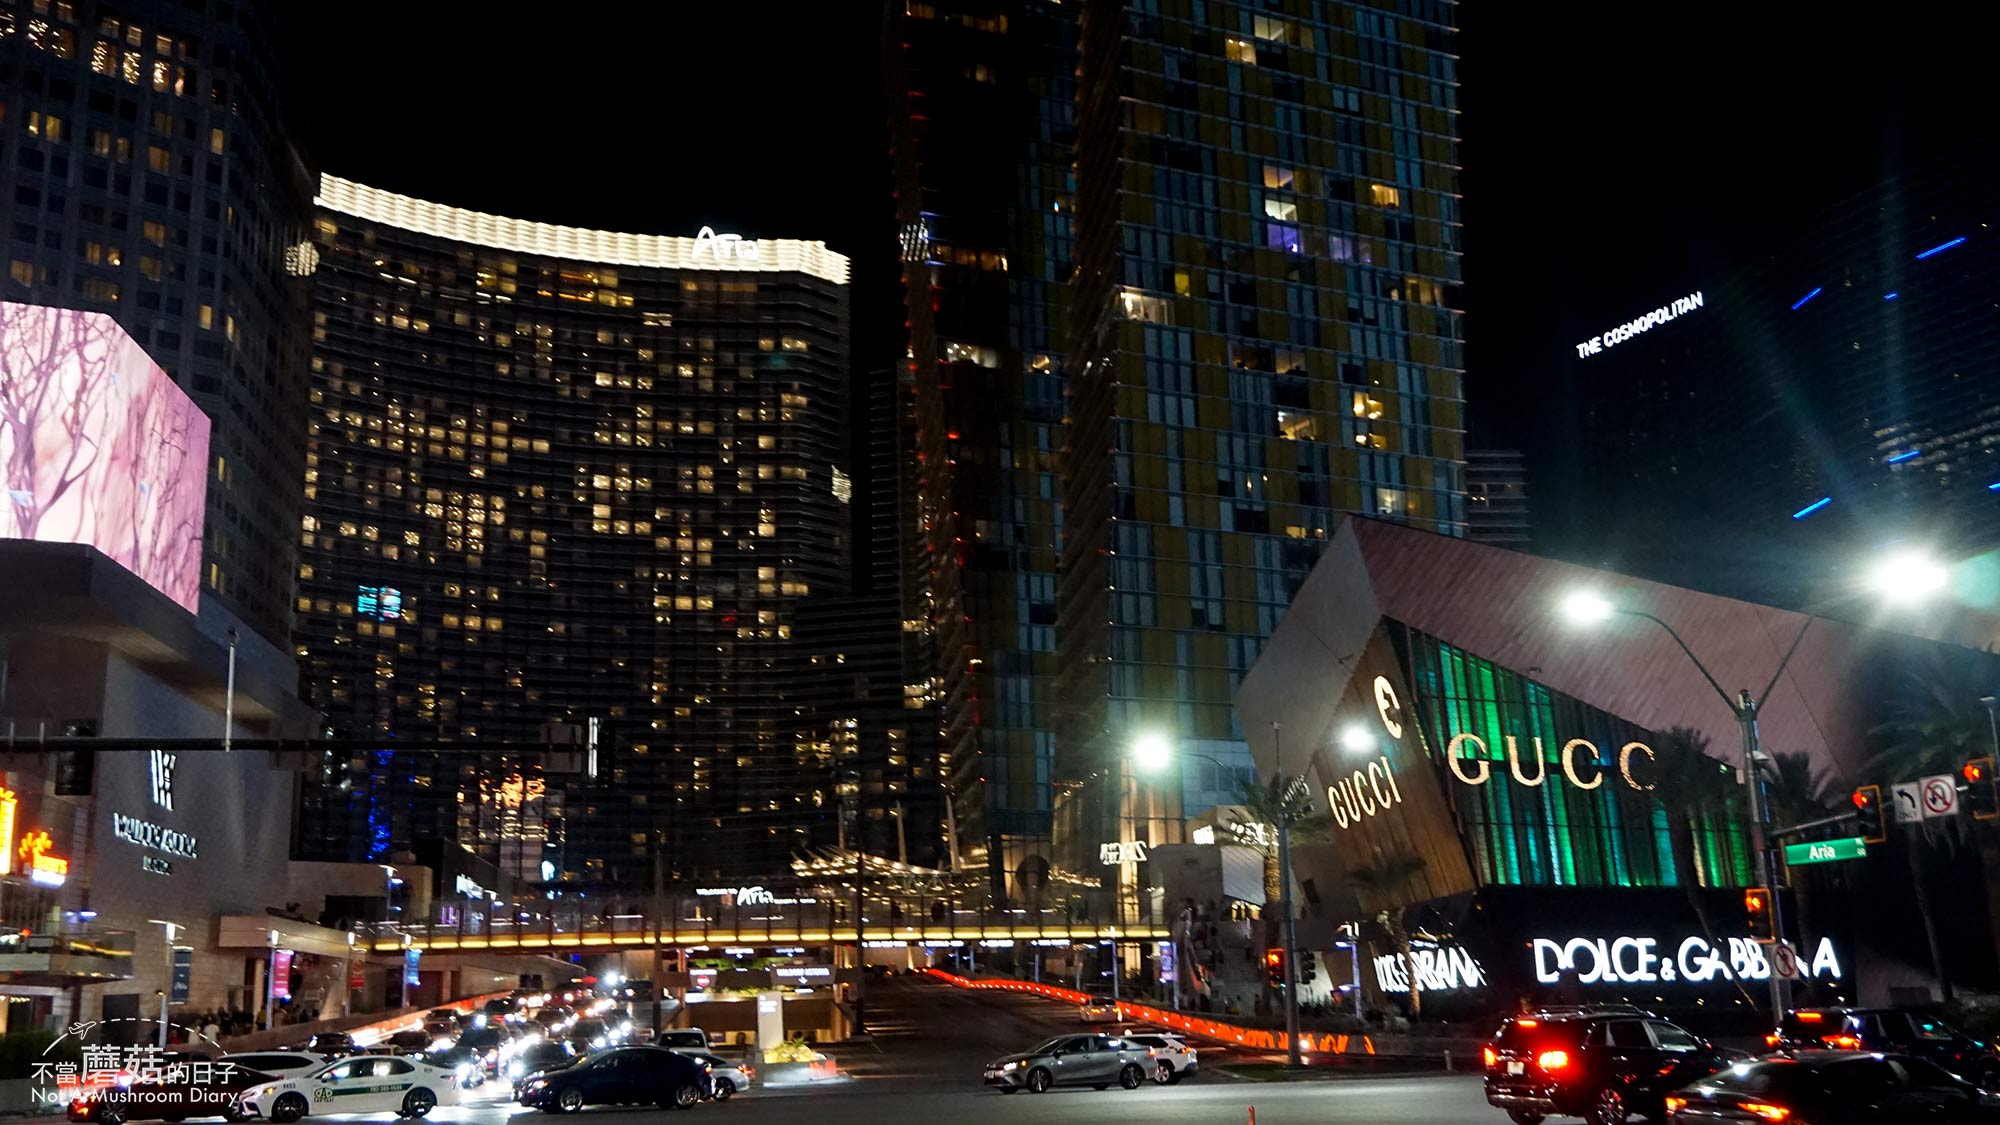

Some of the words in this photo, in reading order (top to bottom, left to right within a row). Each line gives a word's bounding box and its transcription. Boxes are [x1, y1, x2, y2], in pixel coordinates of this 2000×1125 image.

[1576, 336, 1602, 358] THE
[1603, 291, 1703, 347] COSMOPOLITAN
[1448, 733, 1657, 790] GUCC
[1328, 756, 1401, 829] GUCCI
[1809, 844, 1835, 860] Aria
[1533, 937, 1656, 983] DOLCE
[1660, 957, 1676, 981] &
[1678, 937, 1841, 980] GABBA
